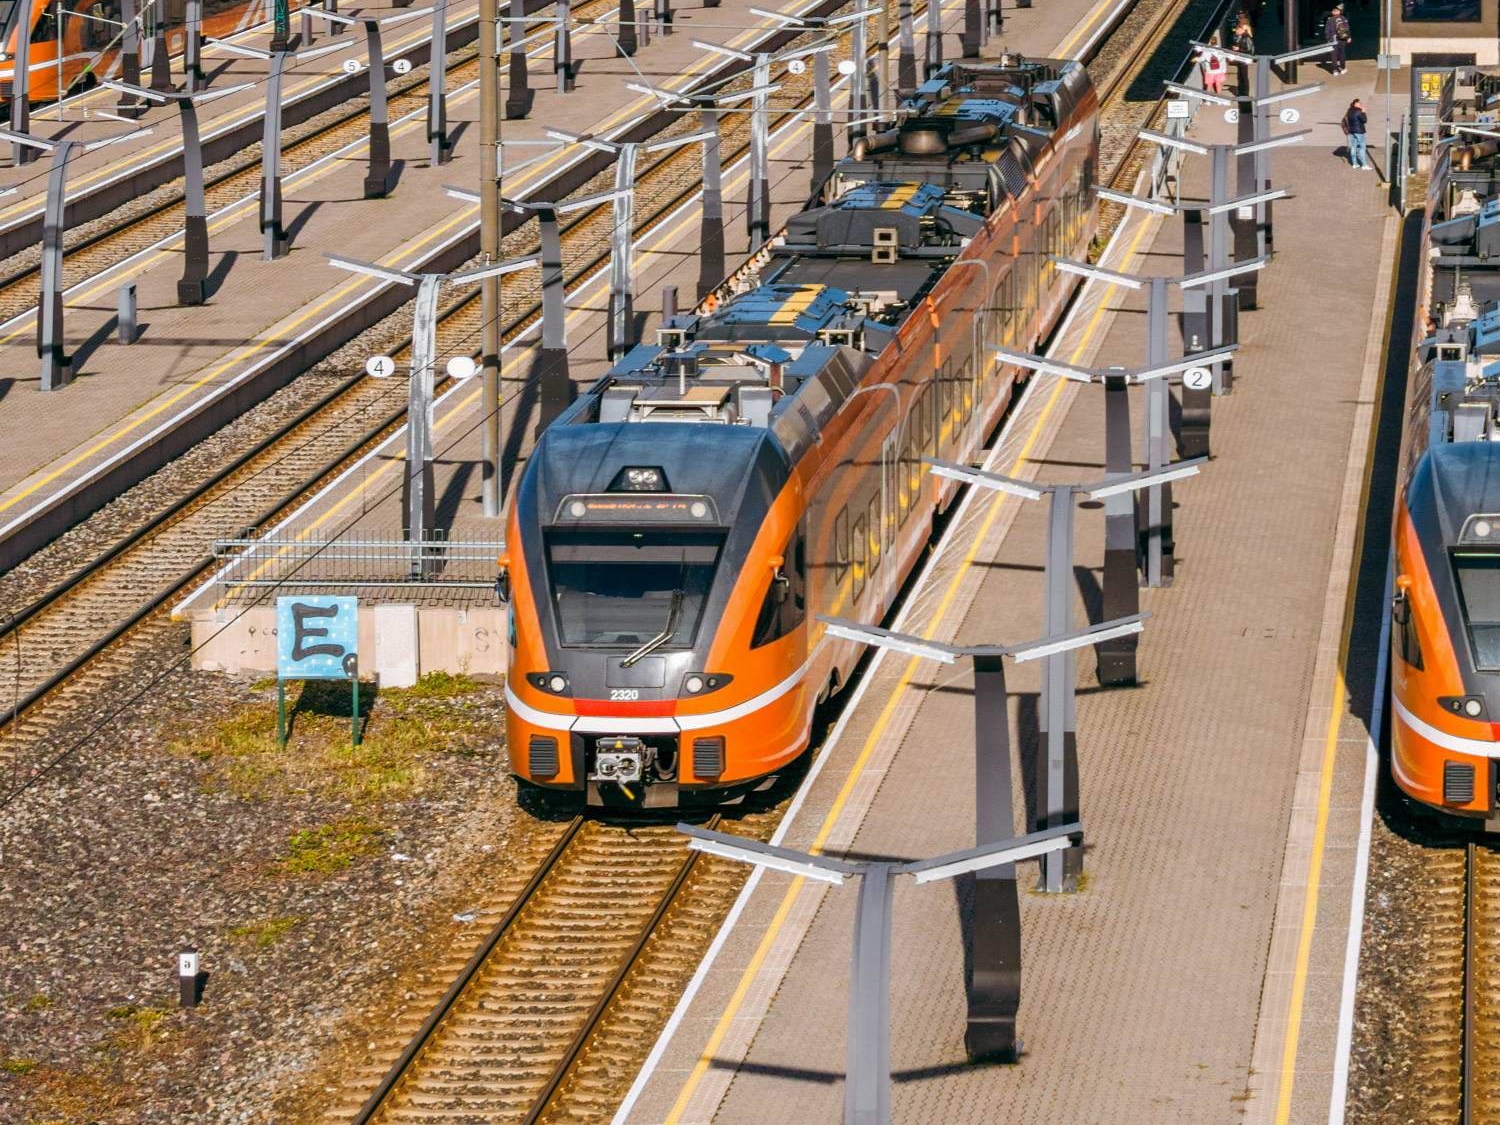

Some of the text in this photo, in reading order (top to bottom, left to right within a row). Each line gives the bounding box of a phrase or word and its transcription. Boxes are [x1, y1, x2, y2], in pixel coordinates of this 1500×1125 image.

[349, 61, 355, 72] 5
[398, 62, 405, 72] 4
[1230, 110, 1238, 122] 3
[1286, 110, 1294, 122] 2
[373, 360, 385, 375] 4
[1192, 371, 1203, 387] 2
[610, 689, 639, 700] 2320
